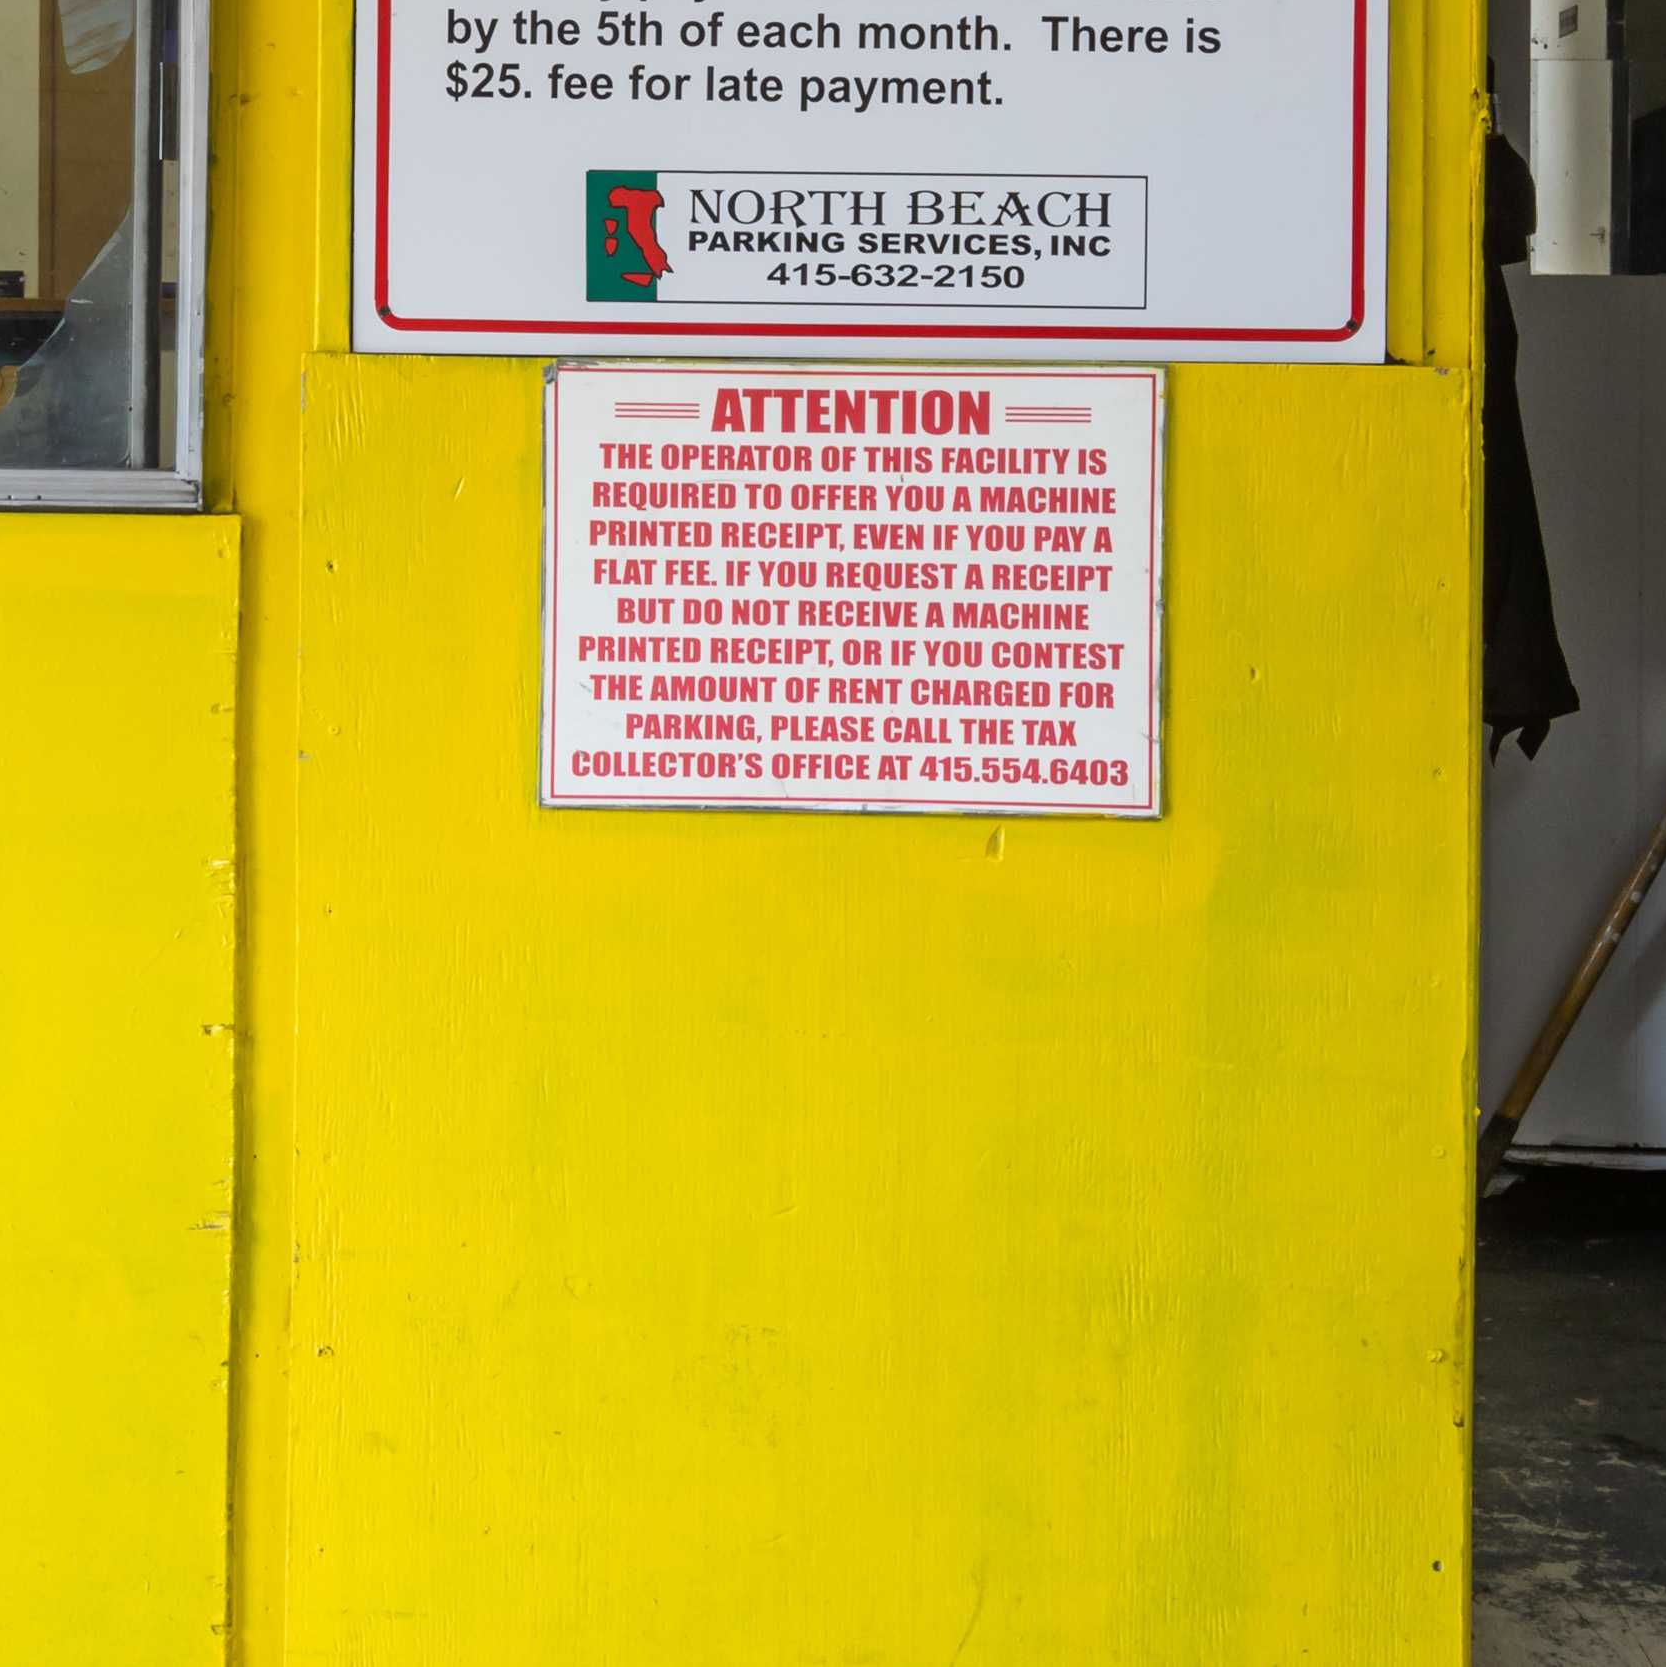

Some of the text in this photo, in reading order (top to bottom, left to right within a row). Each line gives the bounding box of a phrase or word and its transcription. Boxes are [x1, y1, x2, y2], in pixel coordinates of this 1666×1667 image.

[690, 190, 1111, 228] NORTH BEACH
[689, 231, 1110, 260] PARKING SERVICES, INC
[767, 263, 1024, 288] 415-632-2150
[711, 388, 990, 435] ATTENTION
[626, 714, 1077, 746] PARKING, PLEASE CALL THE TAX
[772, 753, 870, 780] OFFICE
[877, 755, 912, 780] AT
[920, 756, 1128, 786] 415.554.6403
